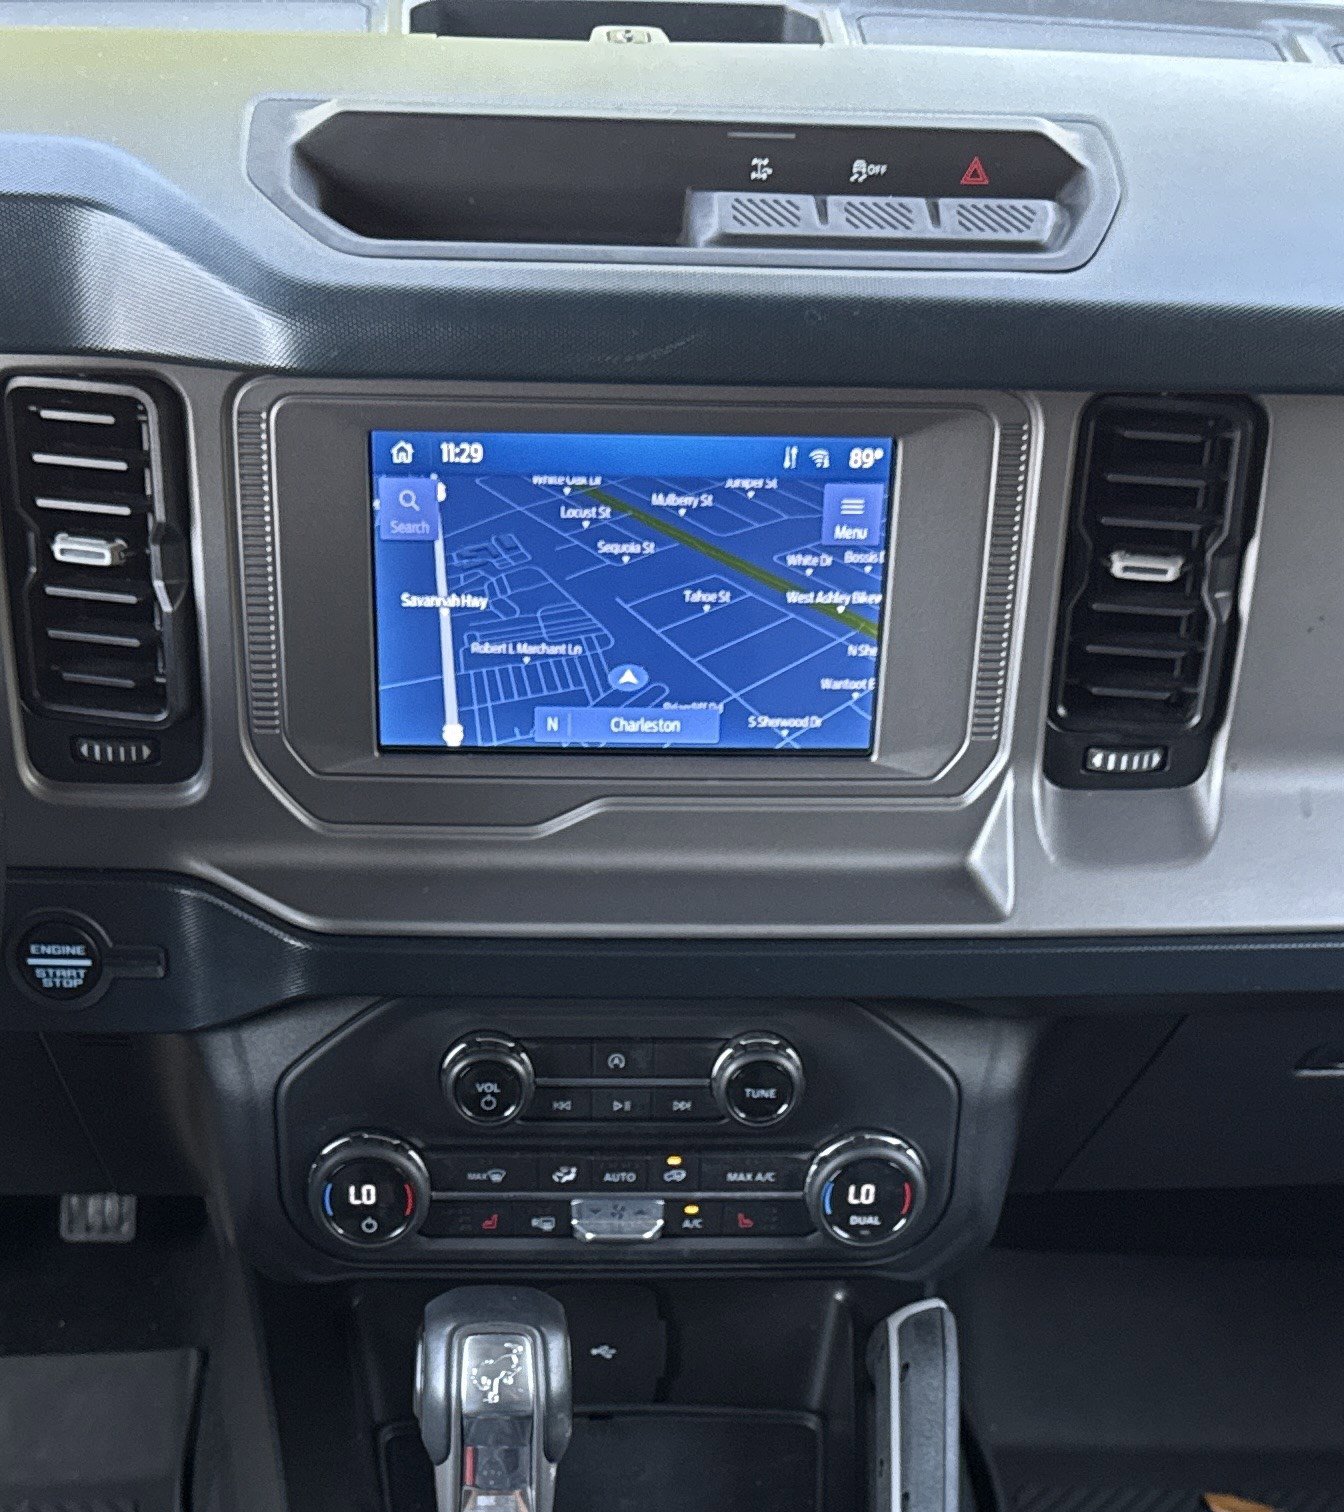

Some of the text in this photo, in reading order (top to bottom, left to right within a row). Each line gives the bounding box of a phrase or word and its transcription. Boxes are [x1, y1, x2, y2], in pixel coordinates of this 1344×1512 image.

[440, 441, 484, 463] 11:29
[651, 493, 713, 508] Mulberry St
[560, 505, 612, 519] Locust St
[390, 520, 430, 534] Search
[833, 524, 868, 540] Menu
[597, 539, 655, 556] Sequoia St
[400, 592, 488, 609] Savannah Hwy
[717, 590, 731, 603] St
[786, 590, 815, 603] West
[816, 590, 851, 606] Ashley
[546, 716, 558, 731] N
[610, 717, 680, 733] Charleston
[757, 716, 809, 728] Sherwood
[810, 716, 823, 728] Dr
[30, 944, 86, 955] ENGINE
[35, 968, 86, 979] START
[42, 978, 83, 988] STOP
[475, 1082, 500, 1093] VOL
[744, 1087, 777, 1099] TUNE
[603, 1172, 637, 1182] AUTO
[726, 1171, 776, 1182] MAX A/C
[681, 1218, 703, 1229] A/C
[849, 1214, 882, 1227] DUAL
